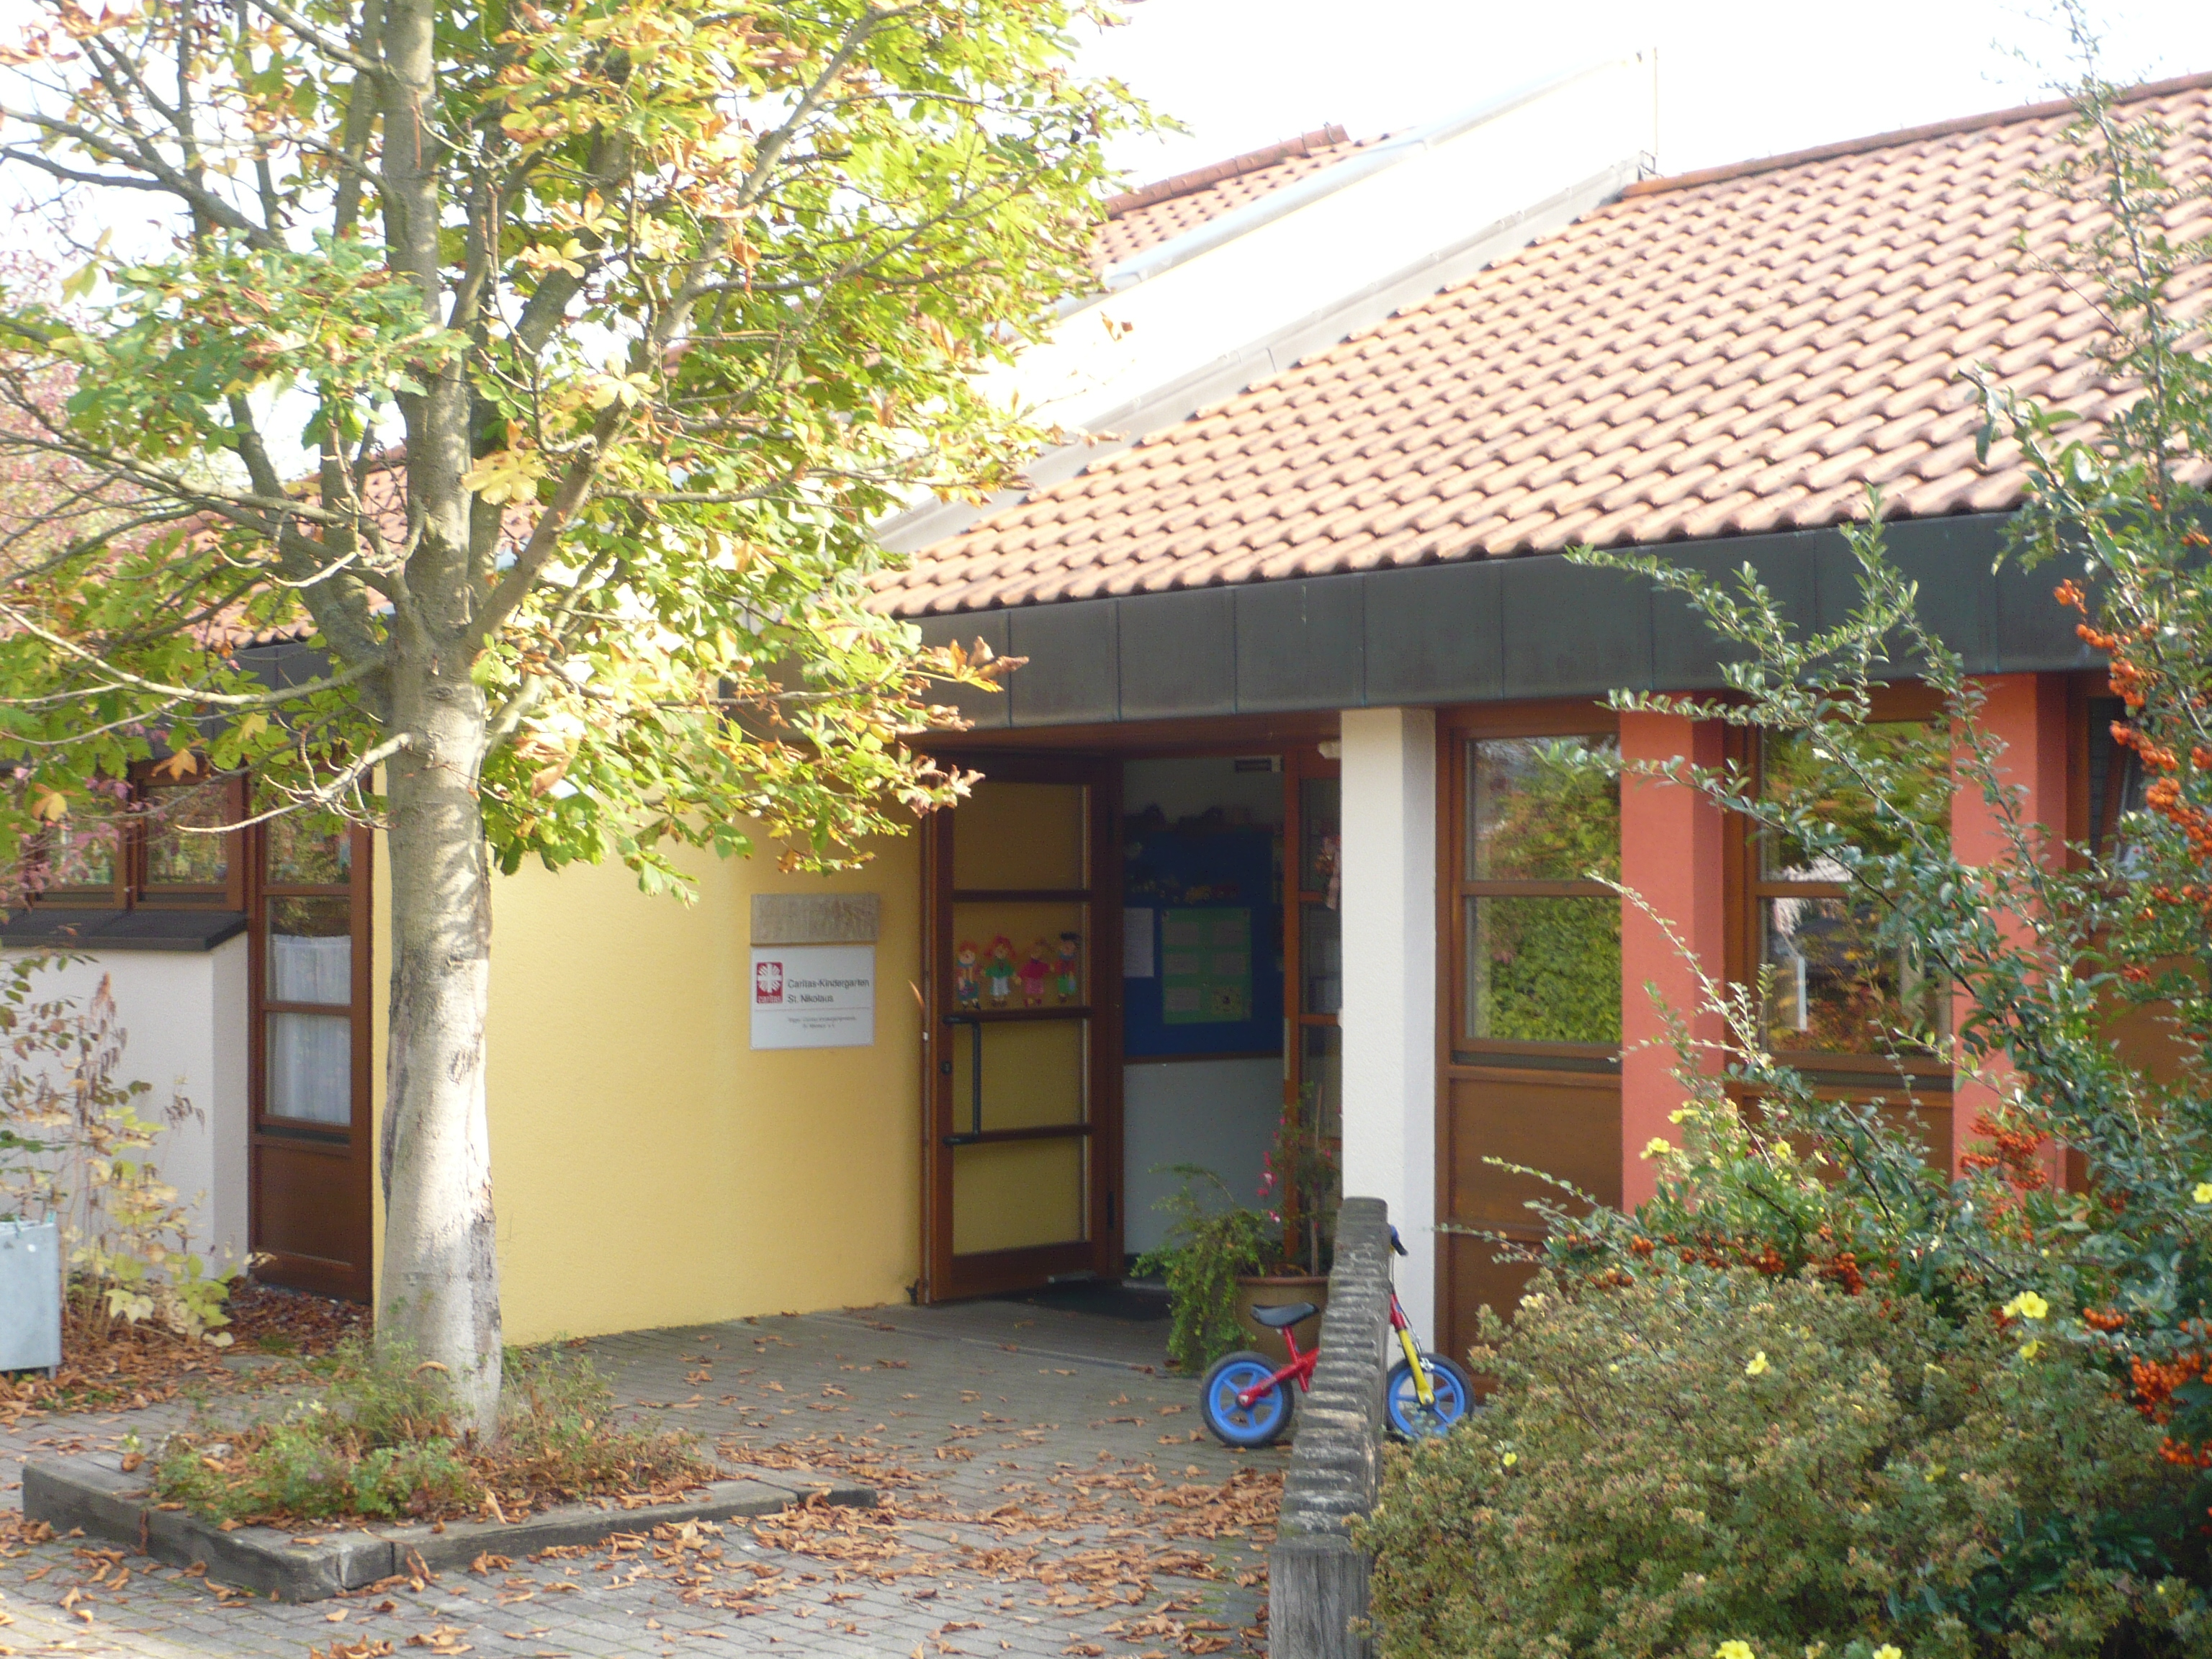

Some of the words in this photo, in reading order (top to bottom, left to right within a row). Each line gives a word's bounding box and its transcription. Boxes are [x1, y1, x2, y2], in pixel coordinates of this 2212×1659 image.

[788, 978, 870, 989] Caritas-Kindergarten
[788, 994, 799, 1004] St.
[800, 994, 834, 1004] Nikolaus
